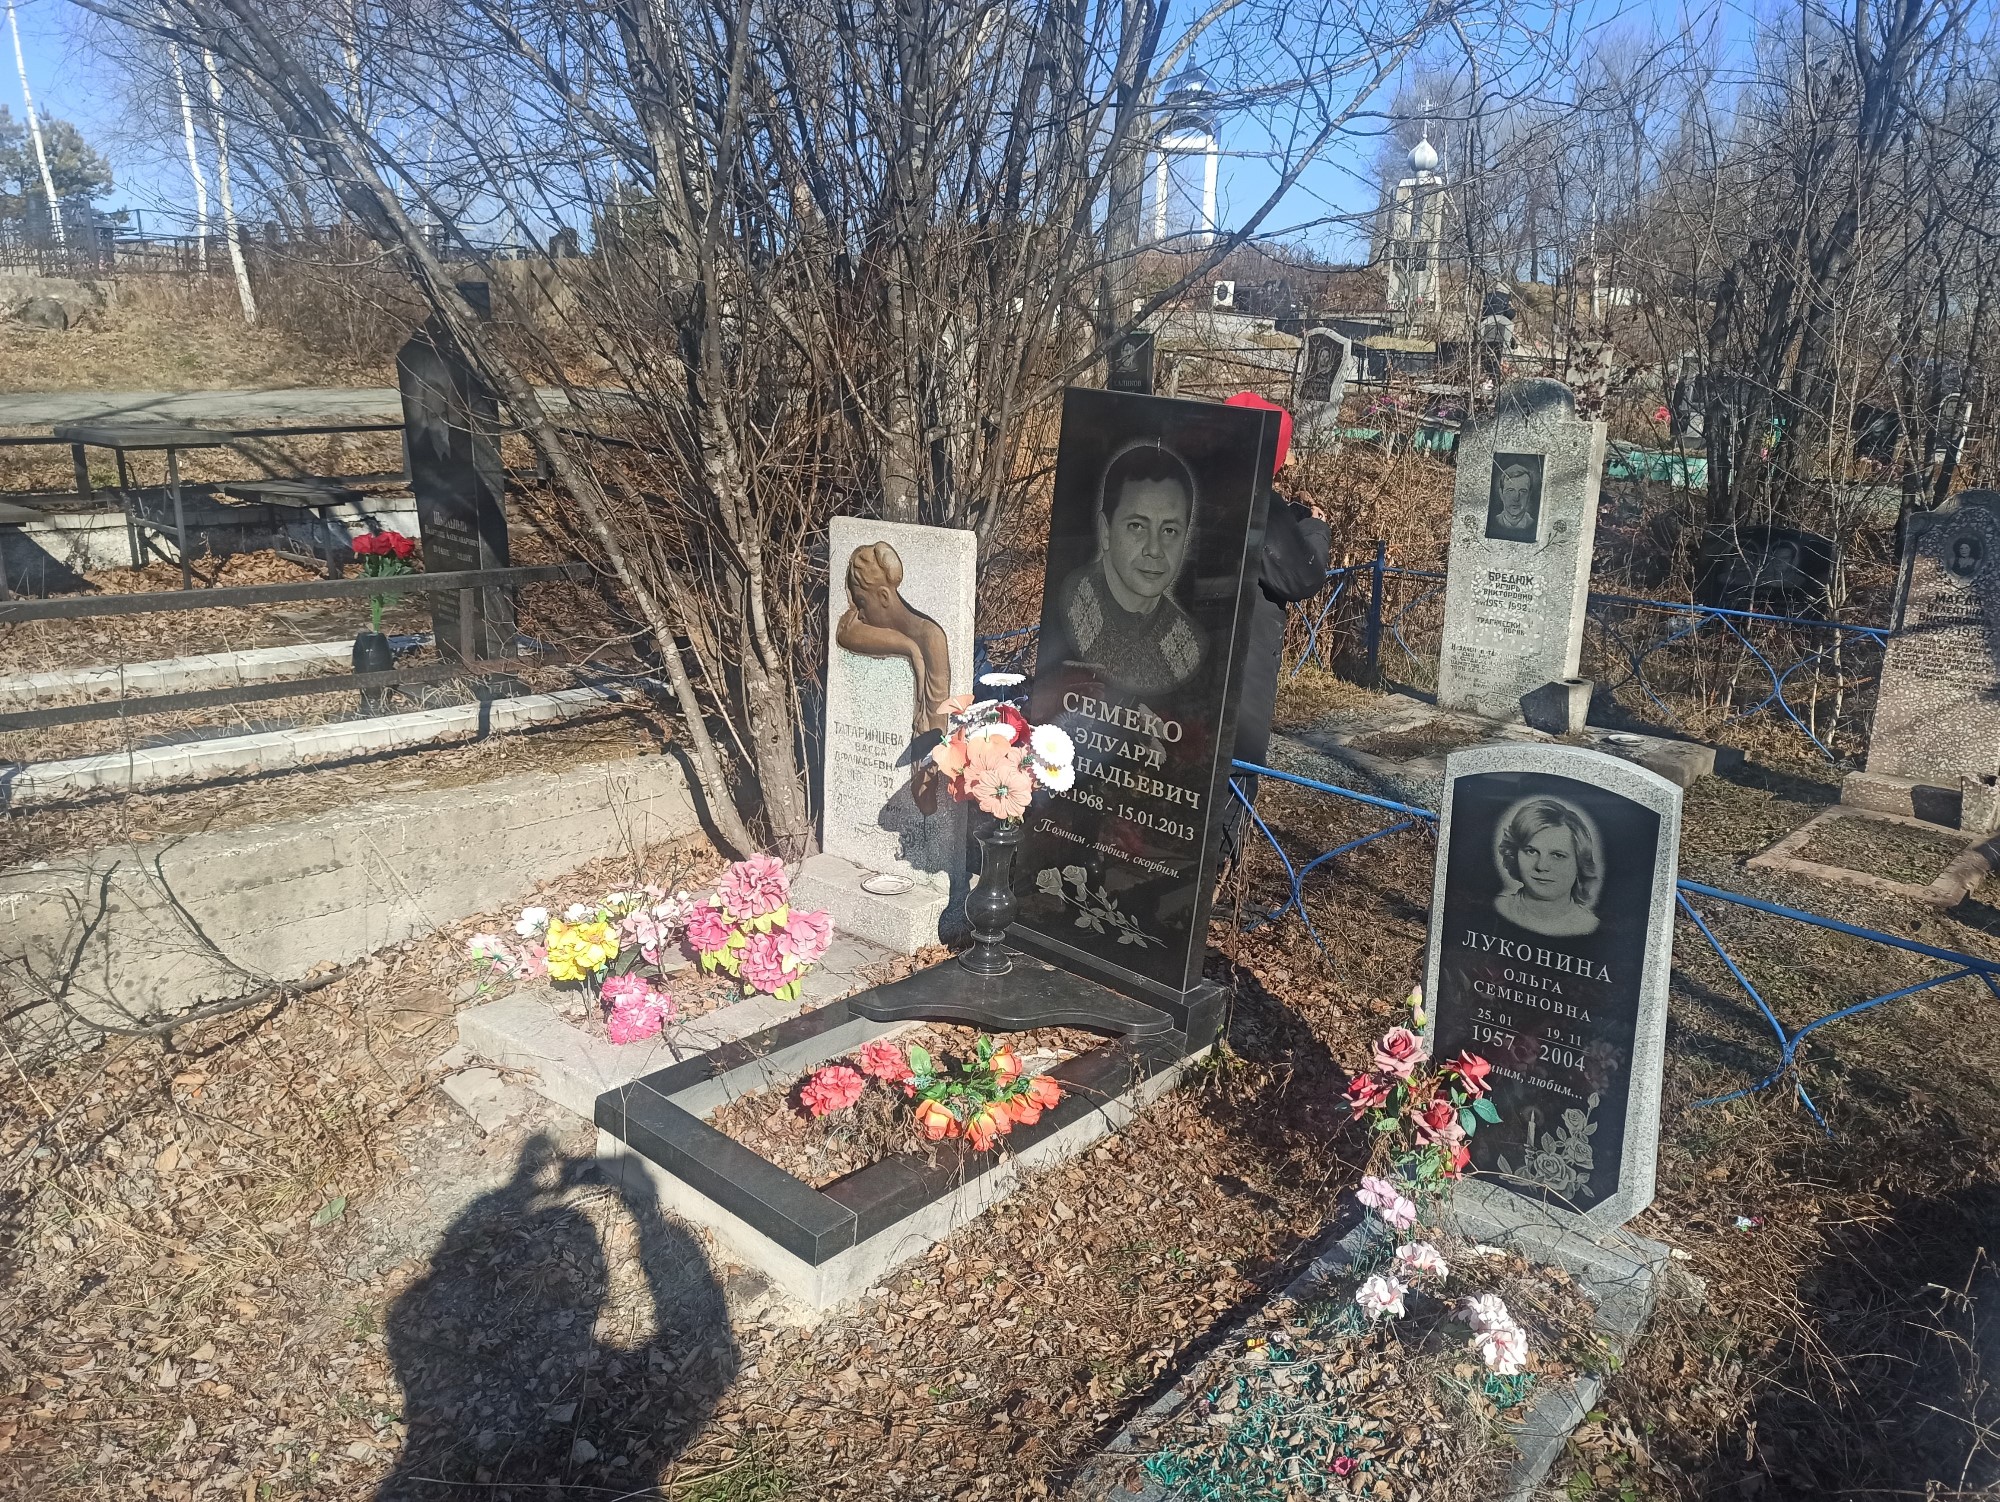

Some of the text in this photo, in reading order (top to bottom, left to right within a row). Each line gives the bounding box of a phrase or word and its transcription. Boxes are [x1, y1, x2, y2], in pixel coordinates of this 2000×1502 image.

[1488, 571, 1534, 586] БРЕДЮК
[833, 720, 905, 747] ТАТАРИНЦЕВА
[1062, 691, 1183, 743] СЕМЕКО
[1074, 727, 1164, 771] ЭДУАРД
[1076, 755, 1201, 810] НАДЬЕВИЧ
[1117, 804, 1195, 841] 15.01.2013
[1092, 839, 1130, 863] любим,
[1132, 855, 1180, 879] скорбим.
[1461, 930, 1614, 984] ЛУКОНИНА
[1503, 968, 1563, 995] ОЛЬГА
[1473, 980, 1592, 1023] СЕМЕНОВНА
[1471, 1025, 1515, 1051] 1957
[1538, 1044, 1586, 1072] 2004
